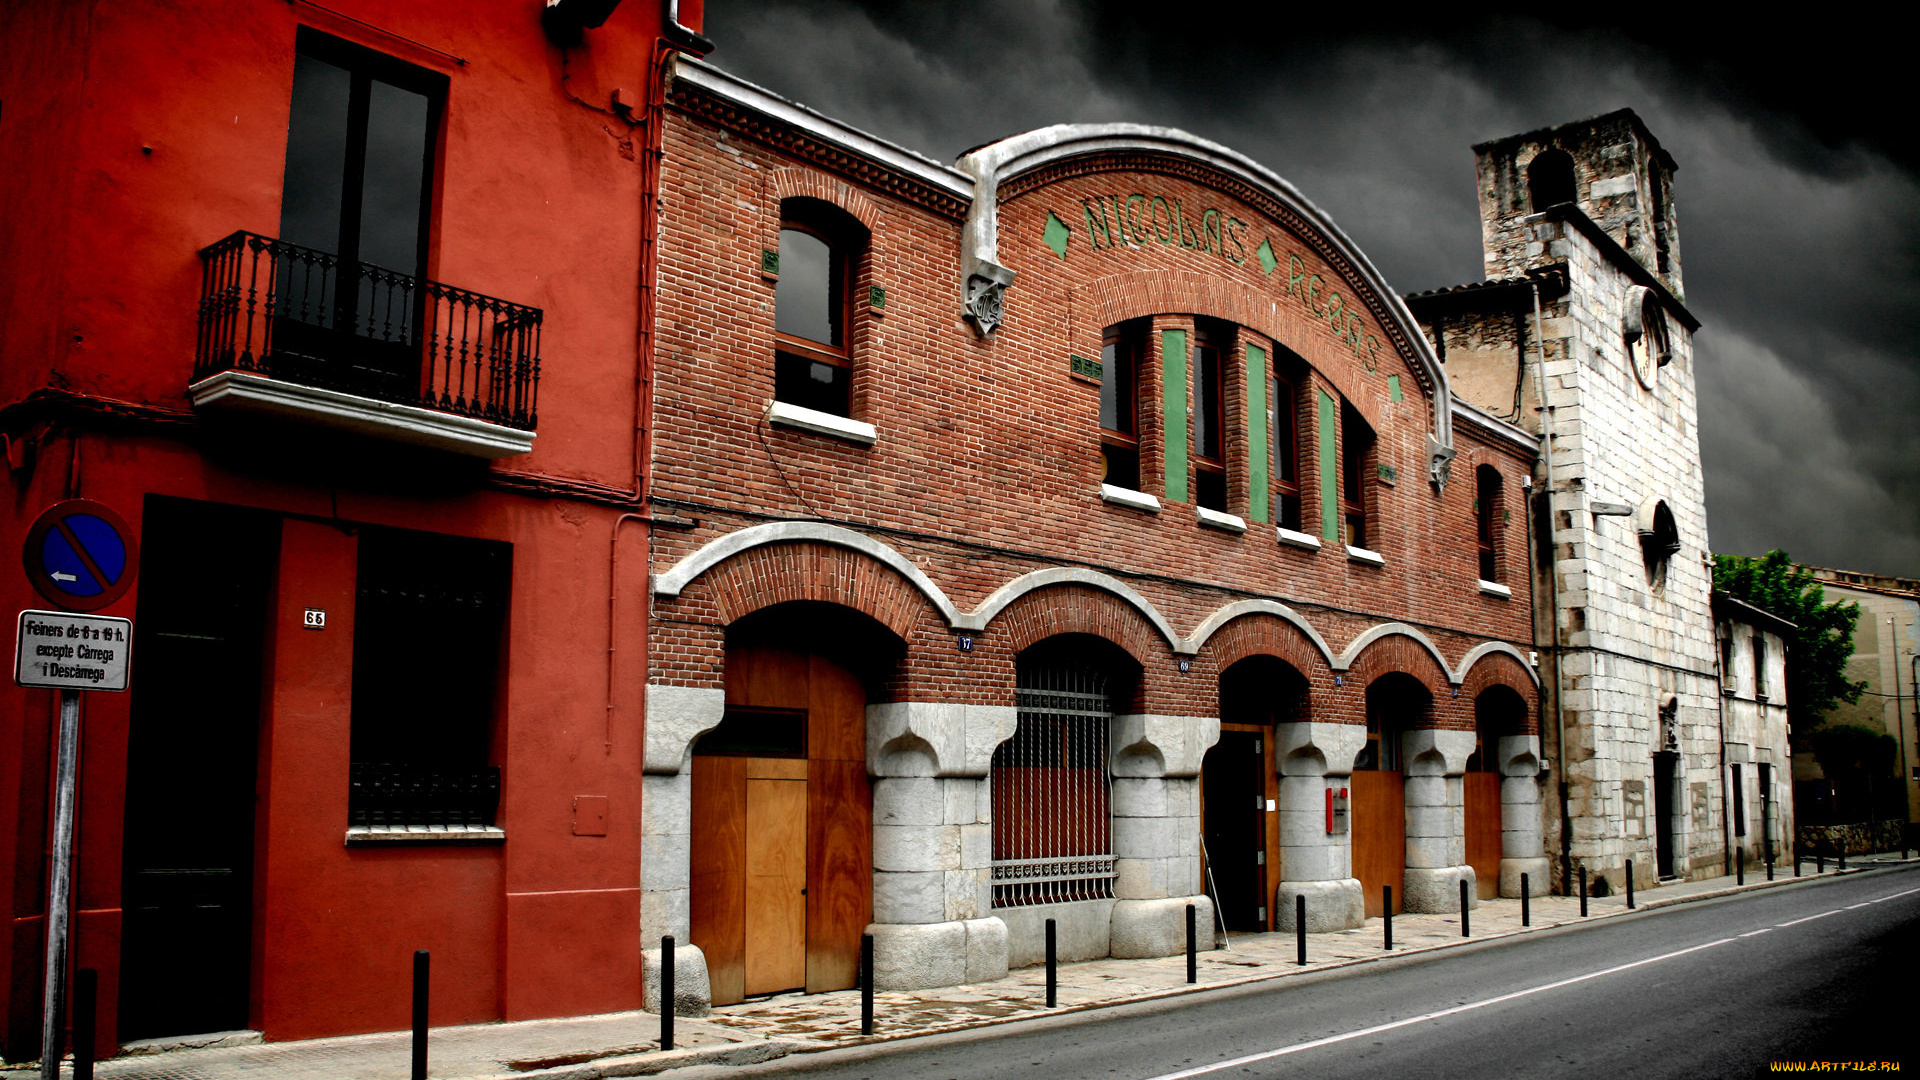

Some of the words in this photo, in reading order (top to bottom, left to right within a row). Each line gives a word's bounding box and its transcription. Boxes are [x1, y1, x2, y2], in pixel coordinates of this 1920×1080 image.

[1079, 193, 1249, 266] NICOLAS
[26, 620, 64, 638] Feiners
[67, 624, 80, 639] de
[82, 625, 90, 639] 8
[92, 629, 99, 640] a
[103, 627, 113, 641] 19
[115, 628, 124, 642] h.
[36, 644, 74, 661] excepte
[77, 644, 114, 664] Càrrega
[42, 662, 48, 676] i
[50, 662, 105, 683] Descàrrega
